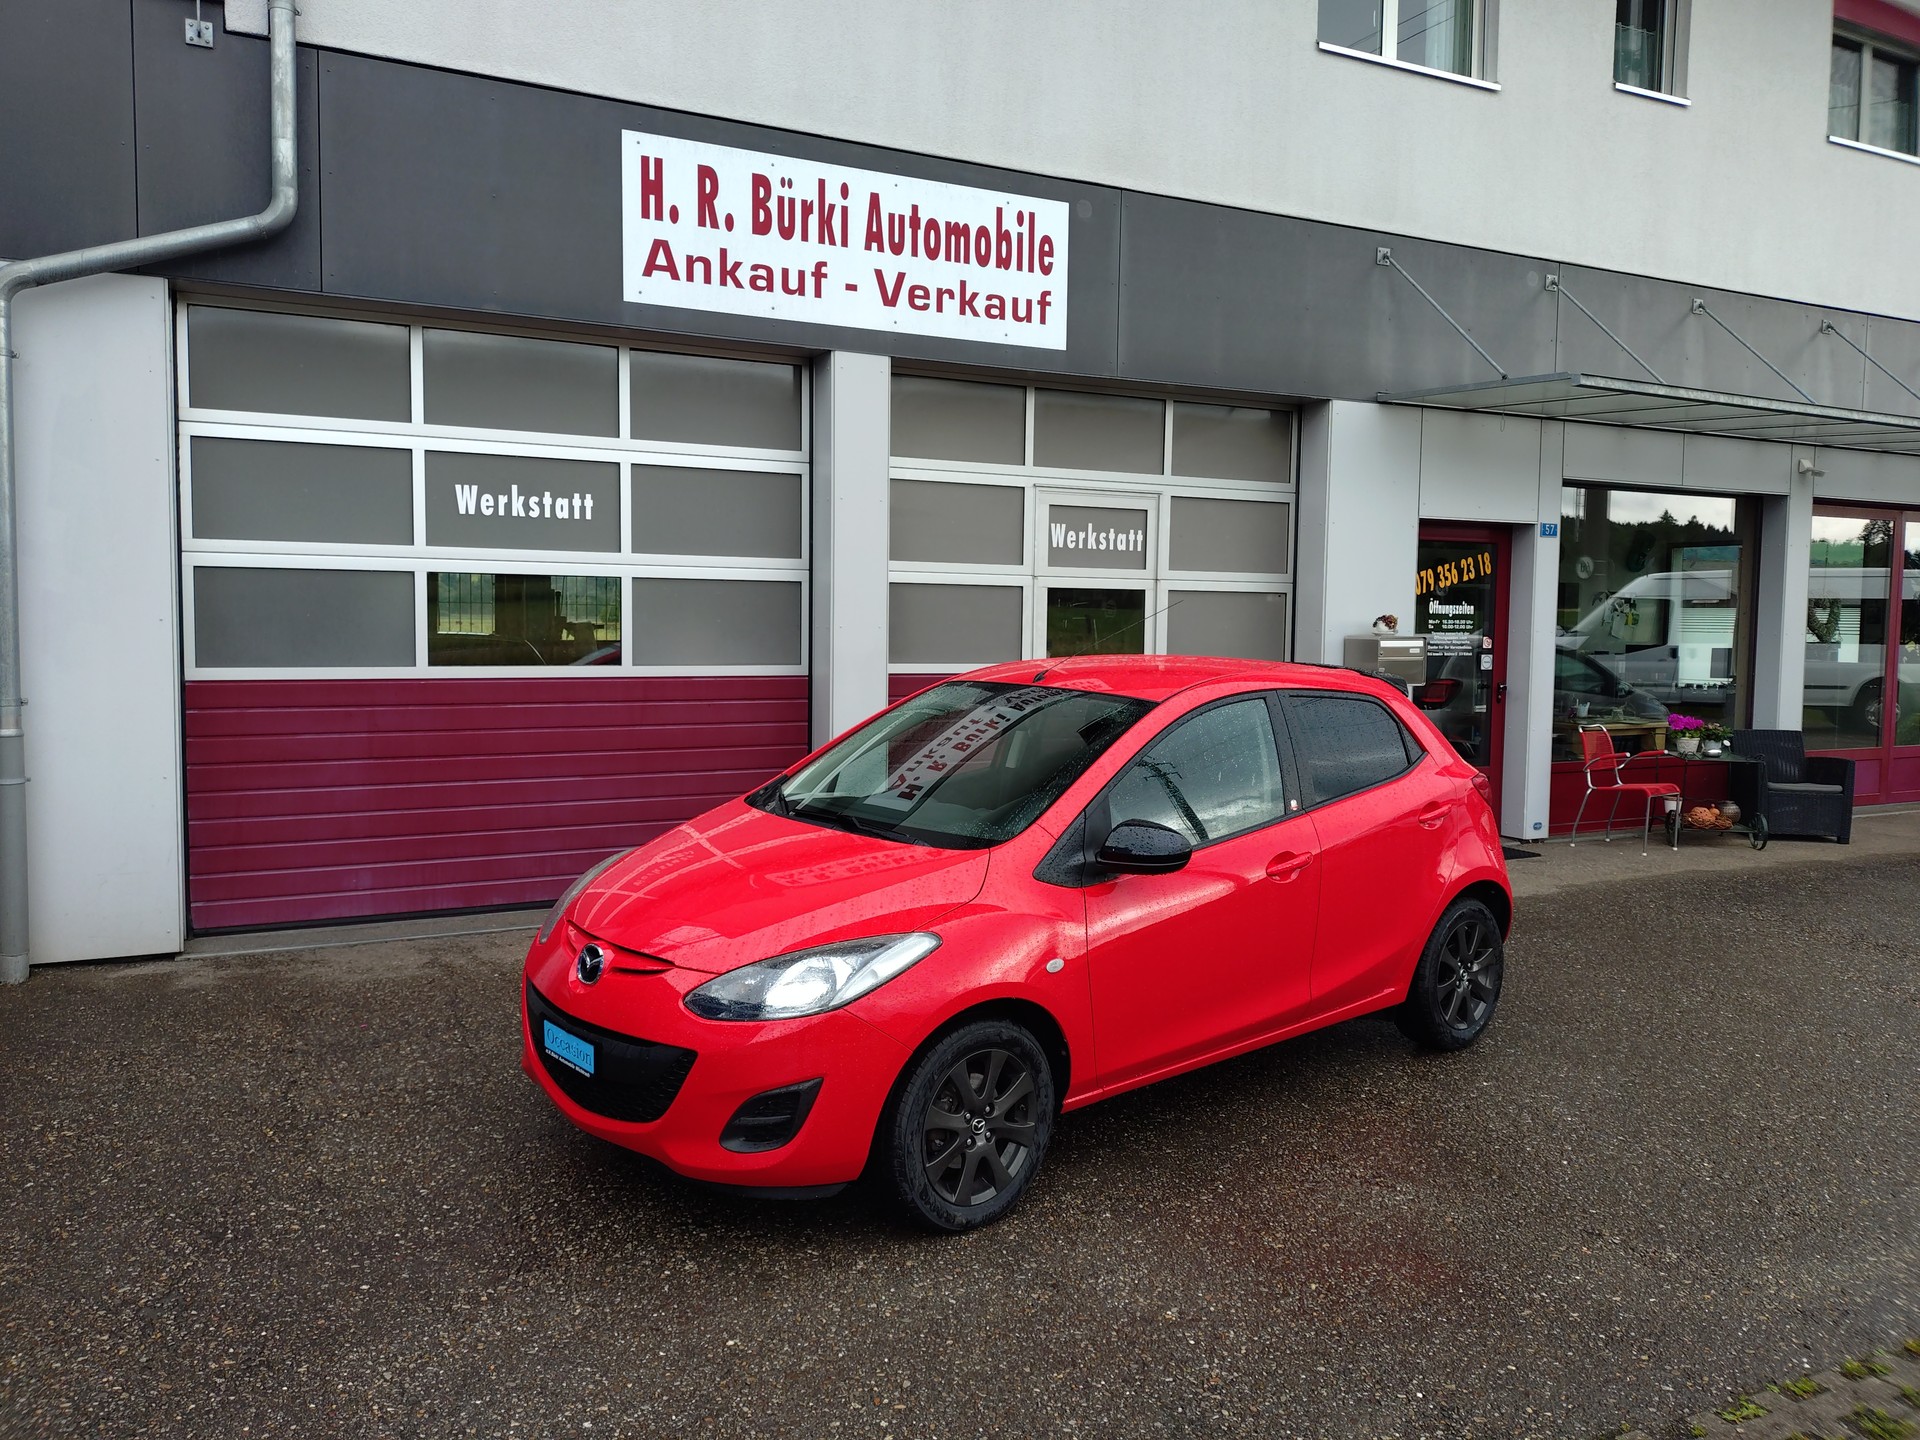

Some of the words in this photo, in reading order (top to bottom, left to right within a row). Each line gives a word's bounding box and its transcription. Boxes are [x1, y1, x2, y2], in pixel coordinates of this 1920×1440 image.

[640, 155, 680, 225] H.
[697, 164, 735, 233] R.
[751, 172, 849, 248] Bürki
[864, 192, 1055, 276] Automobile
[642, 238, 828, 299] Ankauf
[845, 284, 858, 293] -
[874, 268, 1052, 325] Verkauf
[455, 484, 593, 520] Werkstatt
[1050, 523, 1143, 551] Werkstatt
[1545, 524, 1555, 535] 57
[1415, 568, 1435, 596] 079
[1437, 562, 1459, 589] 356
[1460, 556, 1476, 582] 23
[1477, 552, 1492, 577] 18
[1428, 597, 1475, 617] Öffnungszeiten
[547, 1028, 592, 1067] Occasion
